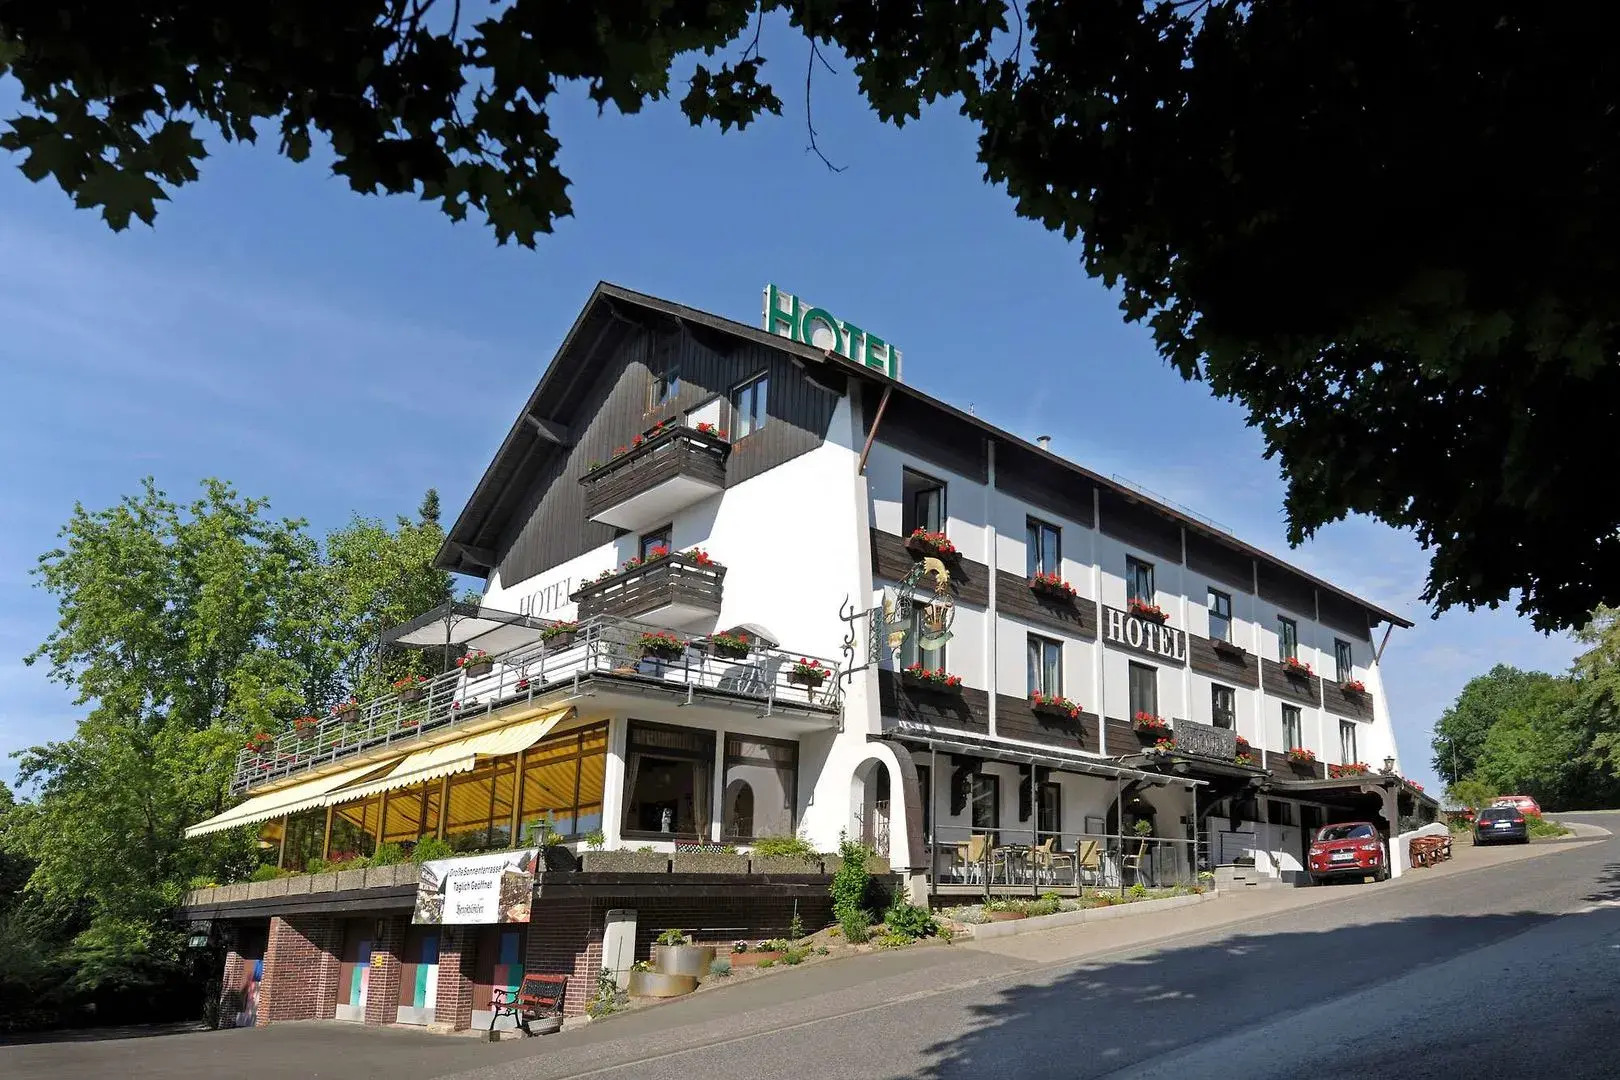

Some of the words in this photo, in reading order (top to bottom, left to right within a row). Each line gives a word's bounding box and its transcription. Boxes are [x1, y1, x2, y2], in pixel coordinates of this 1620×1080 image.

[766, 284, 897, 379] HOTEL
[519, 577, 572, 616] HOTEL
[1107, 608, 1186, 662] HOTEL
